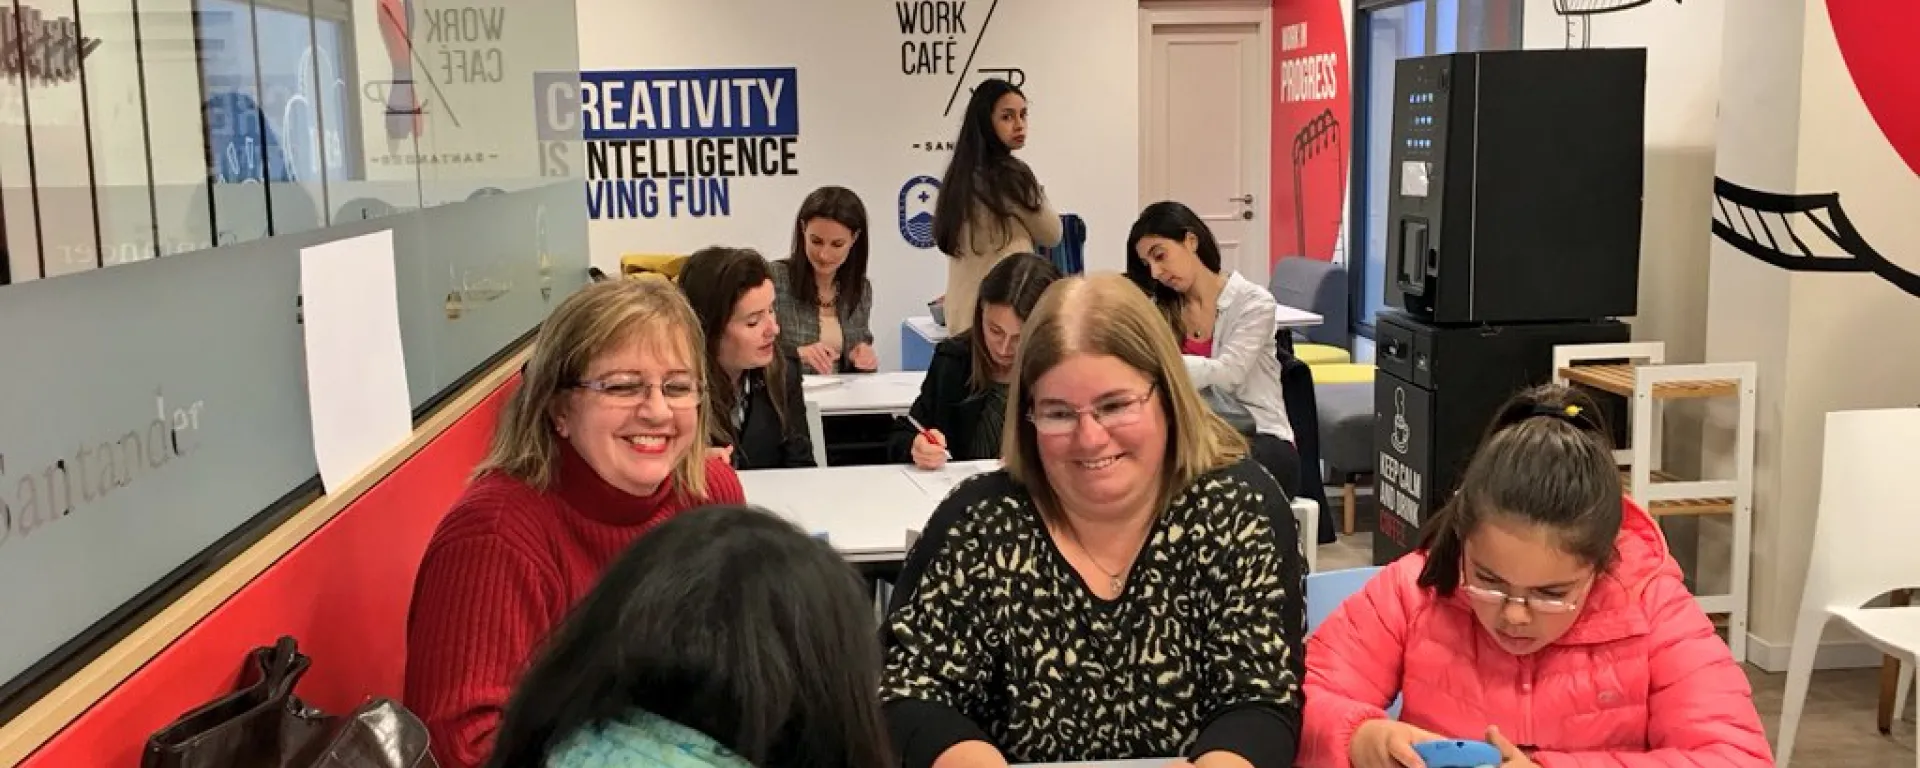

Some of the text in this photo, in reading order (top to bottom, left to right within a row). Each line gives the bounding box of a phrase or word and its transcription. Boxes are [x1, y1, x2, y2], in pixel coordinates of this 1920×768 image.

[896, 1, 966, 34] WORK
[901, 36, 957, 75] CAFÉ
[1281, 52, 1337, 103] PROGRESS
[547, 78, 784, 131] CREATIVITY
[586, 137, 798, 180] NTELLIGENCE
[586, 177, 730, 219] VING FUN
